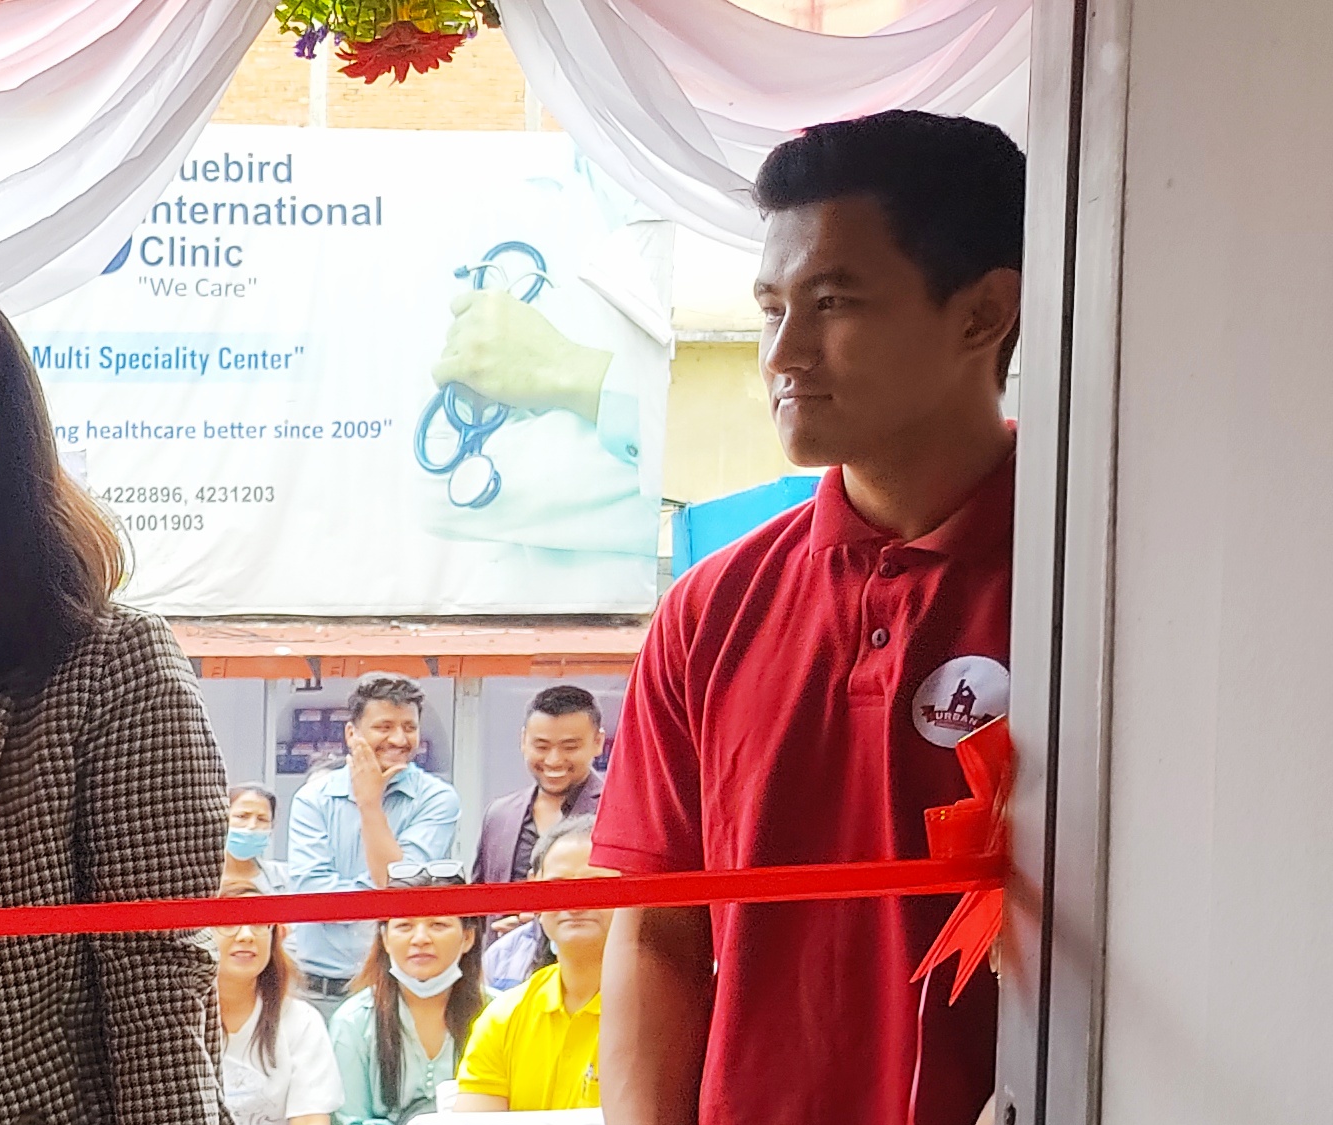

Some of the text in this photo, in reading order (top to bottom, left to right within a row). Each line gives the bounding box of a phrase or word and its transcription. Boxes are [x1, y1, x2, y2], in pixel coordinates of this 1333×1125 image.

[171, 152, 293, 184] uebird
[140, 195, 383, 227] nternational
[139, 235, 244, 268] Clinic
[138, 276, 258, 298] "We Care"
[32, 345, 305, 377] Multi Speciality Center"
[54, 419, 393, 444] ng healthcare better since 2009"
[195, 486, 275, 503] 4231203
[118, 513, 205, 532] 1001903
[935, 711, 979, 727] URBAN
